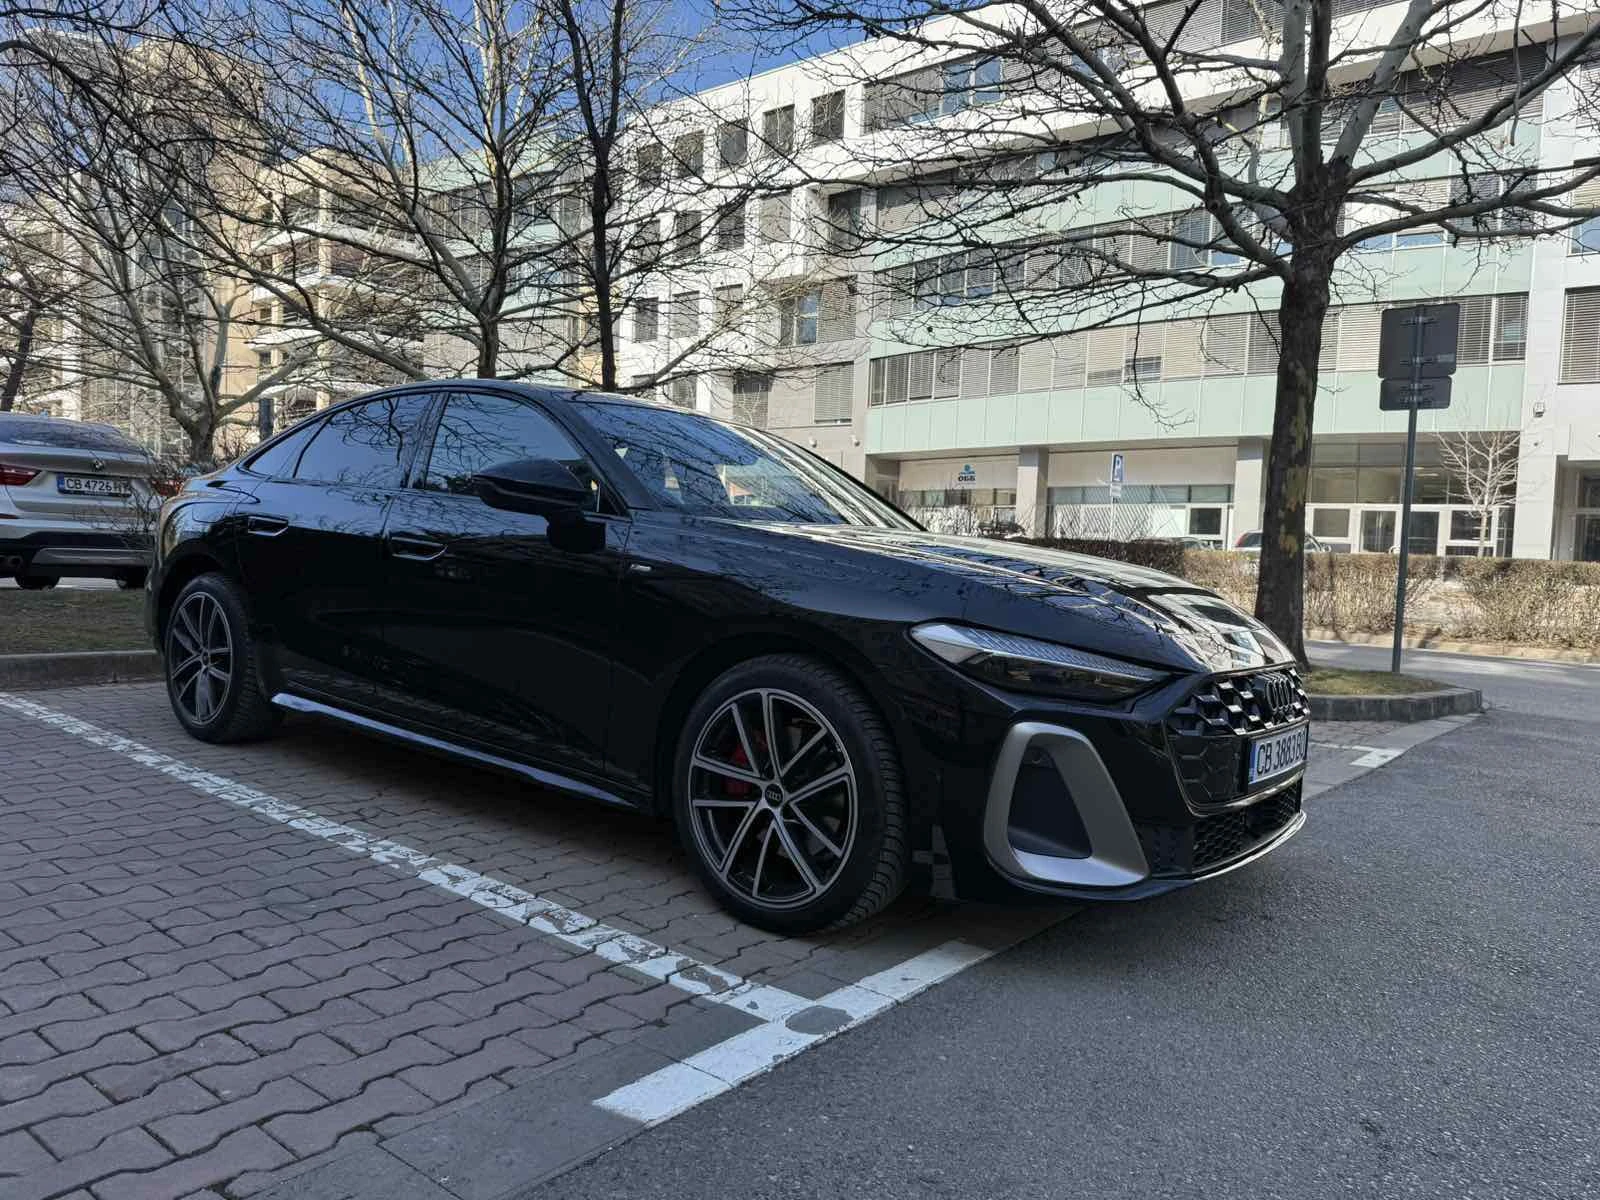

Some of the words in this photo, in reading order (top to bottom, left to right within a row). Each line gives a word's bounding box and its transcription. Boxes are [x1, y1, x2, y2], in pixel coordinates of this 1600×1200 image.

[66, 478, 82, 489] CB
[84, 479, 113, 491] 4726
[1256, 742, 1272, 774] CB
[1273, 734, 1297, 770] 3883
